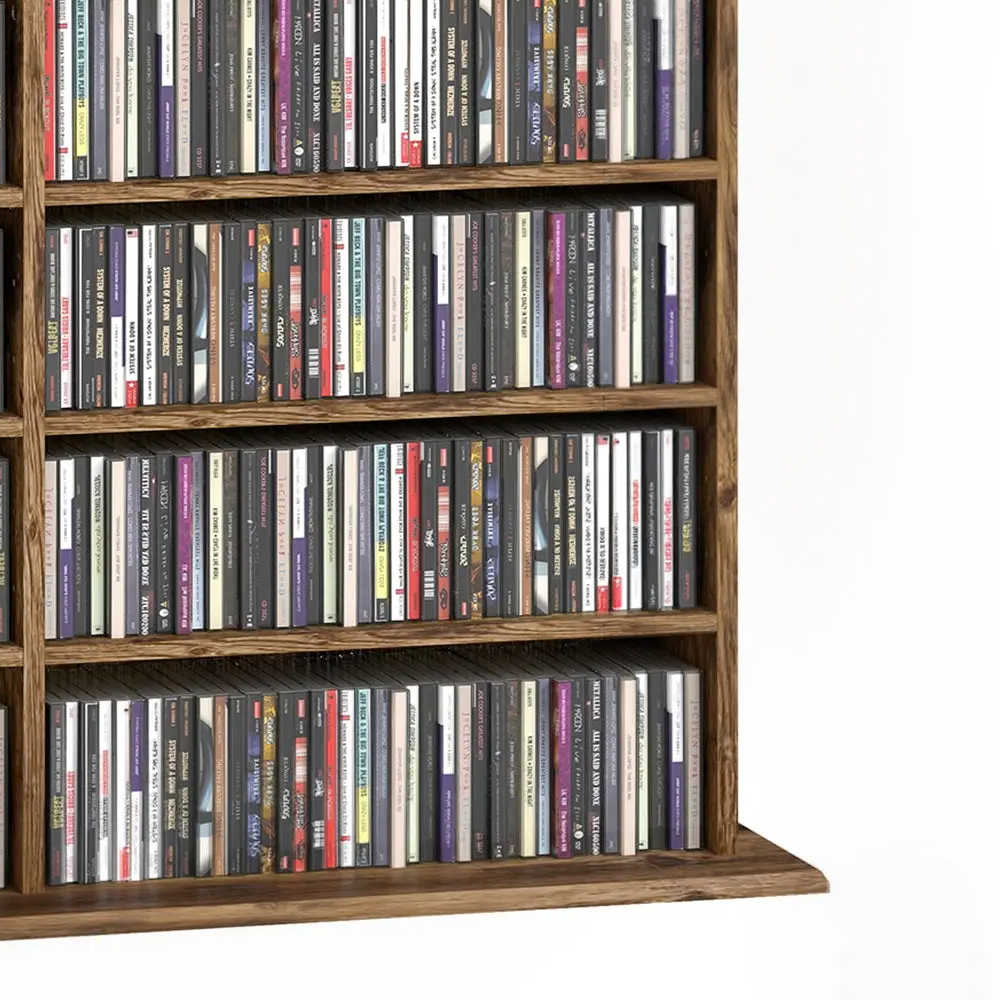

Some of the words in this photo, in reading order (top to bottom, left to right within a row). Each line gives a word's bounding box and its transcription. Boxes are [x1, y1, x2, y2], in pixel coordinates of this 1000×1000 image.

[354, 280, 362, 297] TOWN
[592, 681, 600, 719] METALLICA
[592, 730, 600, 743] ALL
[592, 744, 600, 752] IS
[592, 753, 600, 769] SAID
[592, 771, 600, 786] AND
[592, 787, 600, 806] DONE
